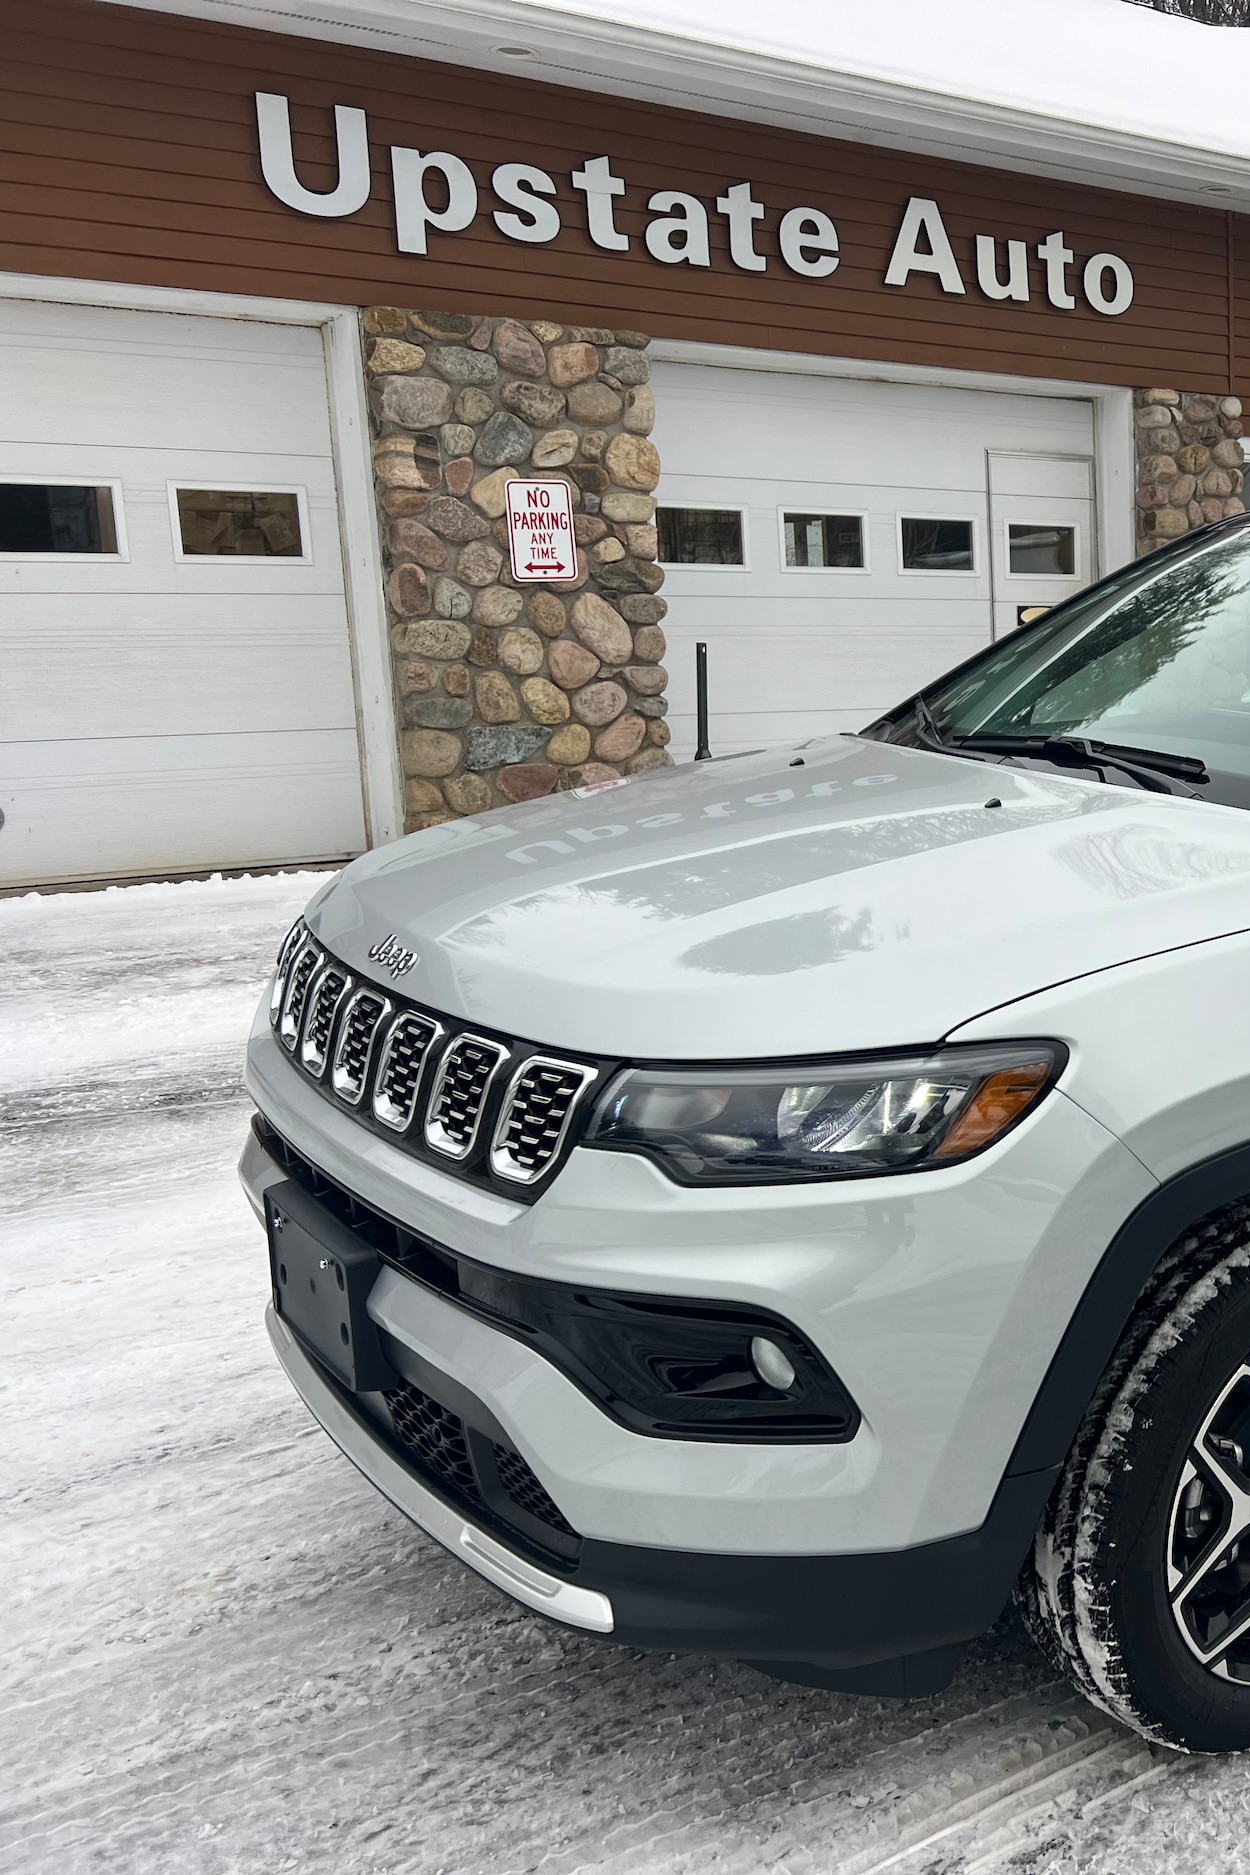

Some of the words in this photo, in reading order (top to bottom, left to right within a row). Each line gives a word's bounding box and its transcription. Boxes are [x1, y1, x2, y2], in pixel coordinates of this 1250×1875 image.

[255, 91, 840, 278] Upstate
[884, 196, 1135, 317] Auto
[526, 489, 550, 508] NO
[513, 511, 568, 530] PARKING
[531, 532, 554, 545] ANY
[530, 547, 558, 560] TIME
[368, 934, 418, 979] Jeep
